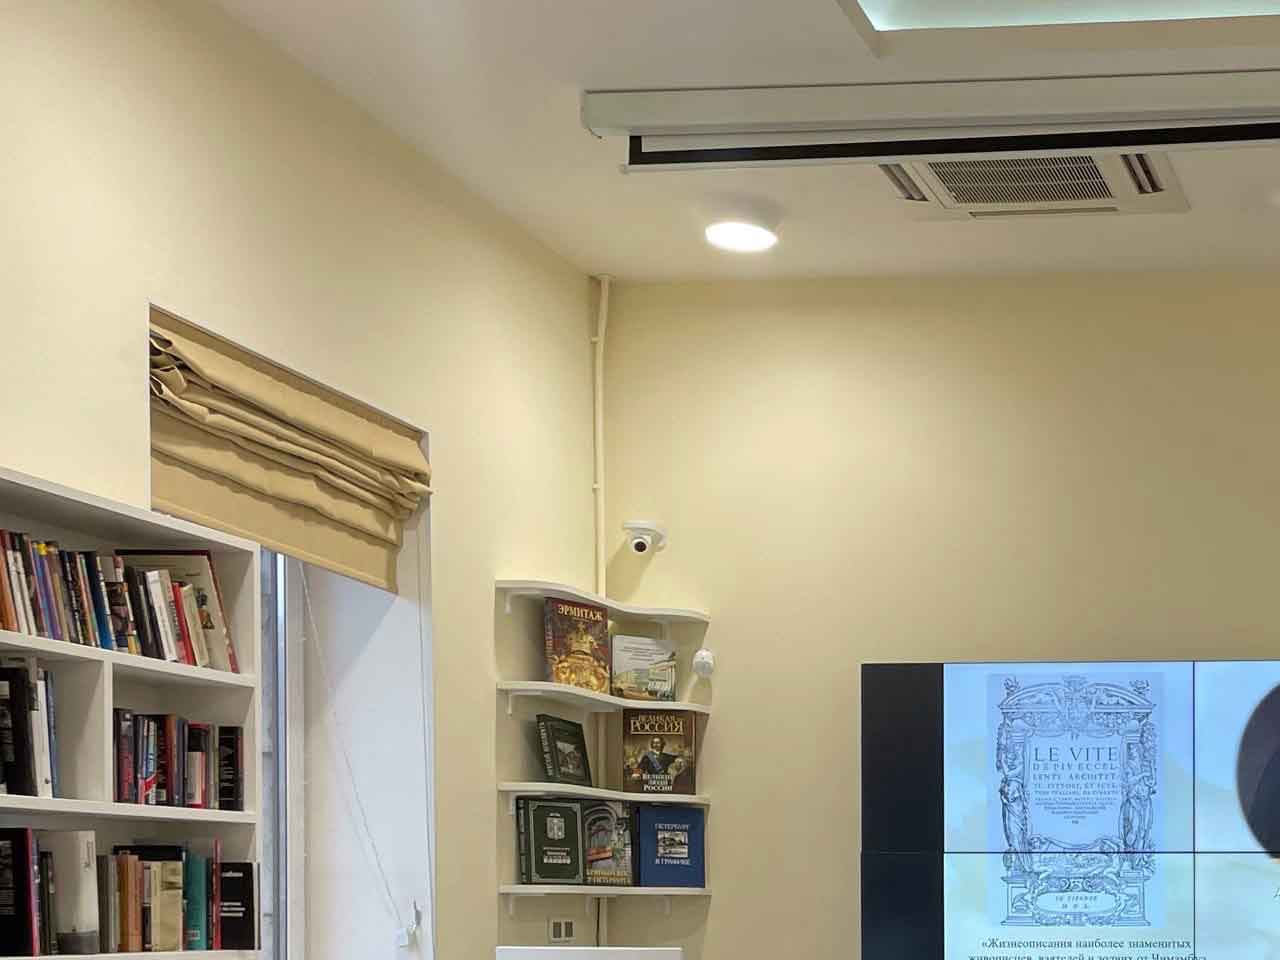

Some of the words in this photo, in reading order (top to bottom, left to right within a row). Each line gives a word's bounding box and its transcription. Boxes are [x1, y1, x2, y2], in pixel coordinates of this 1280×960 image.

[558, 604, 602, 620] ЭРМИТАЖ
[631, 719, 683, 731] РОССИЯ
[1034, 746, 1059, 761] LE
[1070, 746, 1119, 761] VITE
[981, 937, 1073, 949] «Жизнеописания
[1076, 937, 1125, 949] наиболее
[1128, 940, 1192, 949] знаменитых
